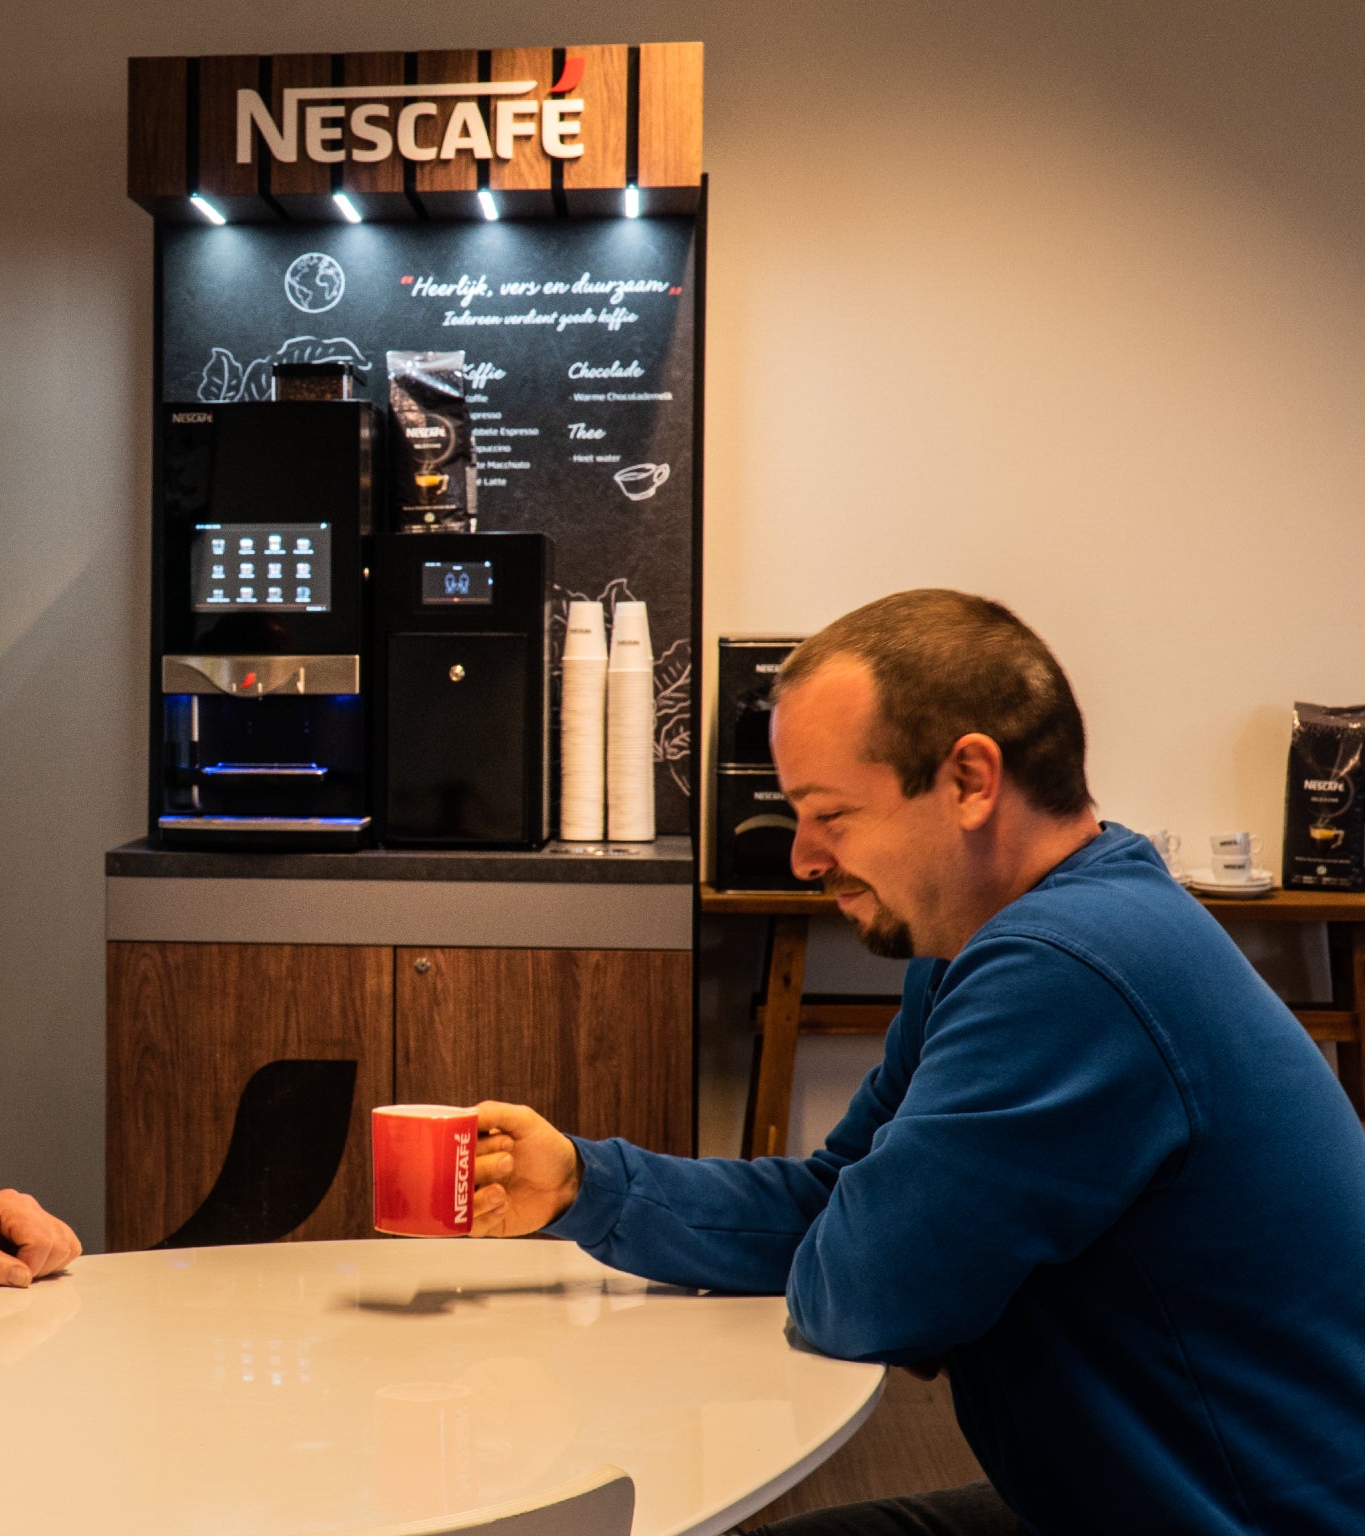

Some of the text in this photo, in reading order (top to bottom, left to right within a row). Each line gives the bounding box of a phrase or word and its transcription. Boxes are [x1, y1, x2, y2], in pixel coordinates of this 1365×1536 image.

[236, 56, 585, 164] NESCAFÉ
[500, 280, 540, 296] vers
[542, 280, 569, 295] en
[442, 307, 639, 332] Iedereen verdient goede koffie
[568, 360, 645, 379] Chocolade
[470, 411, 502, 421] presso
[567, 422, 607, 440] Thee
[1304, 779, 1345, 792] NESCAFÉ
[454, 1132, 471, 1224] NESCAFÉ
